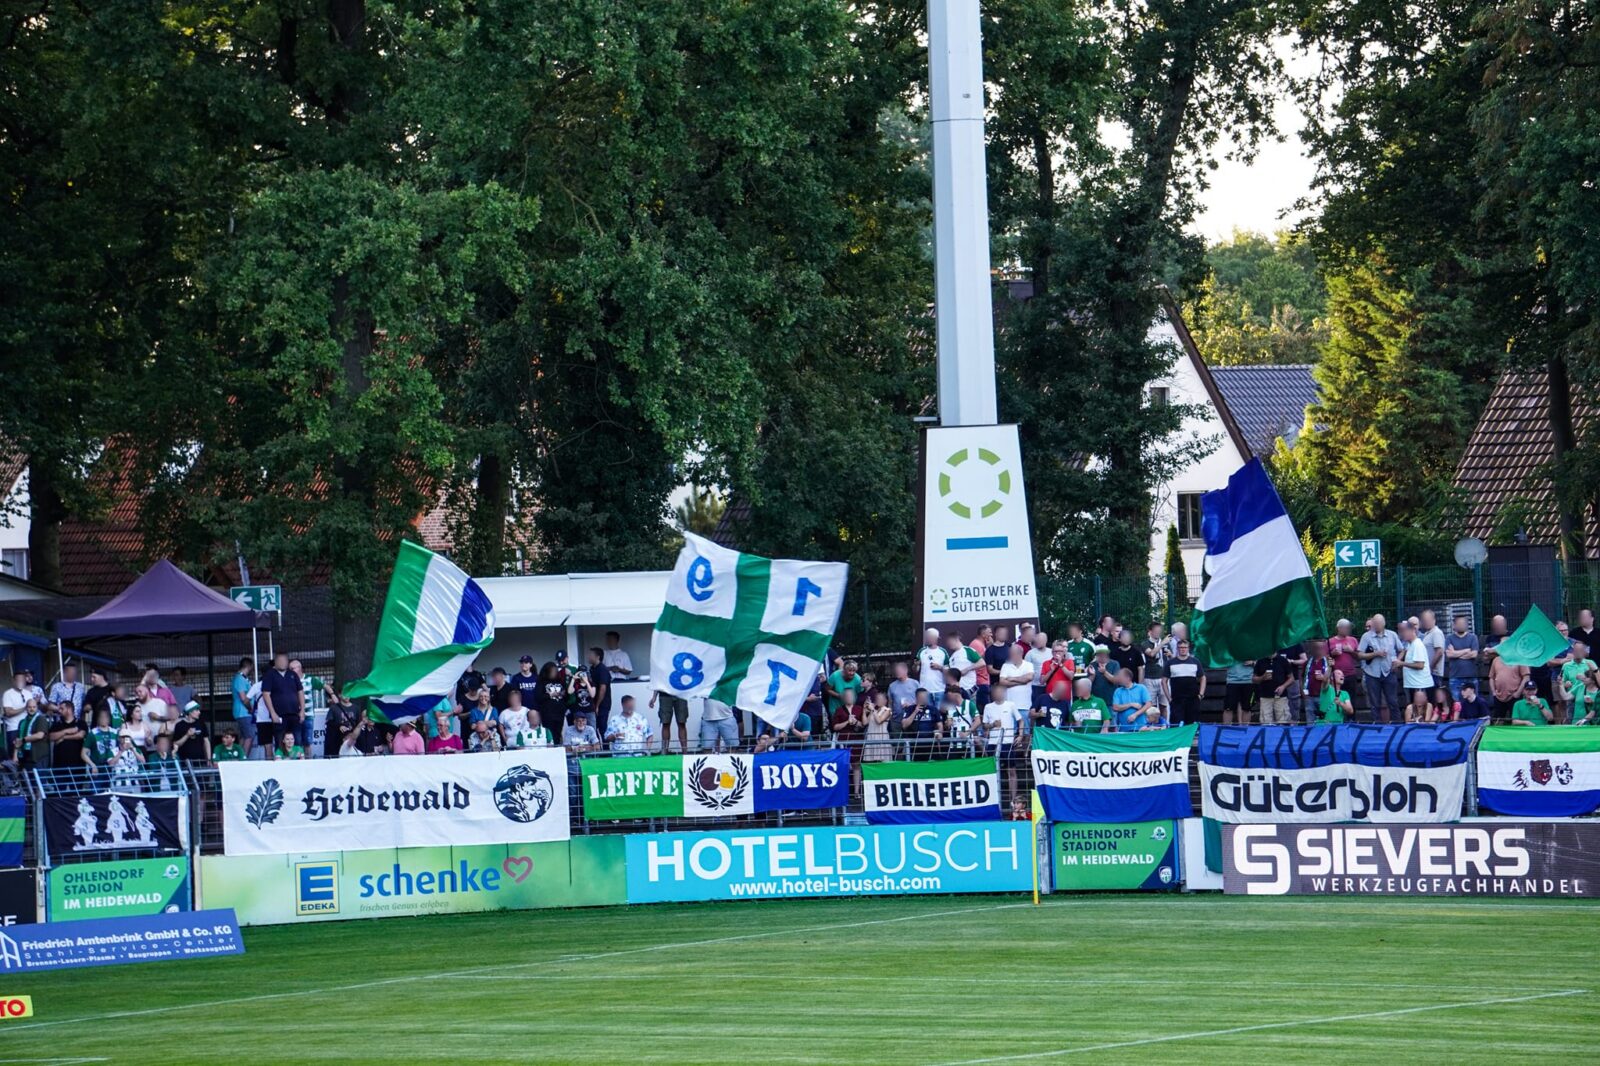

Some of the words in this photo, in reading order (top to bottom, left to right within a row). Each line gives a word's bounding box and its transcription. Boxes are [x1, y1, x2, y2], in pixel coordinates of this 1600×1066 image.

[951, 584, 1030, 599] STADTWERKE
[952, 599, 1019, 613] GÜTERSLOH
[1211, 721, 1473, 769] FANATICS
[1036, 757, 1061, 776] DIE
[1066, 756, 1182, 778] GLÜCKSKURVE
[588, 771, 680, 799] LEFFE
[759, 762, 839, 790] BOYS
[301, 782, 471, 821] Heidewald
[874, 779, 990, 807] BIELEFELD
[1209, 772, 1439, 820] Gütersloh
[1061, 828, 1138, 840] OHLENDORF
[647, 828, 1019, 882] HOTELBUSCH
[1062, 841, 1118, 851] STADION
[1296, 828, 1530, 877] SIEVERS
[1062, 855, 1079, 866] IM
[1082, 853, 1155, 865] HEIDEWALD
[63, 868, 145, 884] OHLENDORF
[359, 859, 501, 898] schenke
[729, 875, 941, 896] www.hotel-busch.com
[1311, 877, 1584, 894] WERKZEUGFACHHANDEL
[63, 881, 124, 896] STADION
[63, 898, 84, 910] IM
[85, 892, 162, 909] HEIDEWALD
[300, 903, 336, 912] EDEKA
[21, 937, 74, 951] Friedrich
[76, 931, 143, 947] Amtenbrink
[144, 929, 180, 941] GmbH
[182, 928, 192, 938] &
[192, 926, 213, 937] Co.
[213, 925, 233, 935] KG
[127, 949, 172, 960] Baugruppen
[183, 944, 237, 955] Werkzeugstahl
